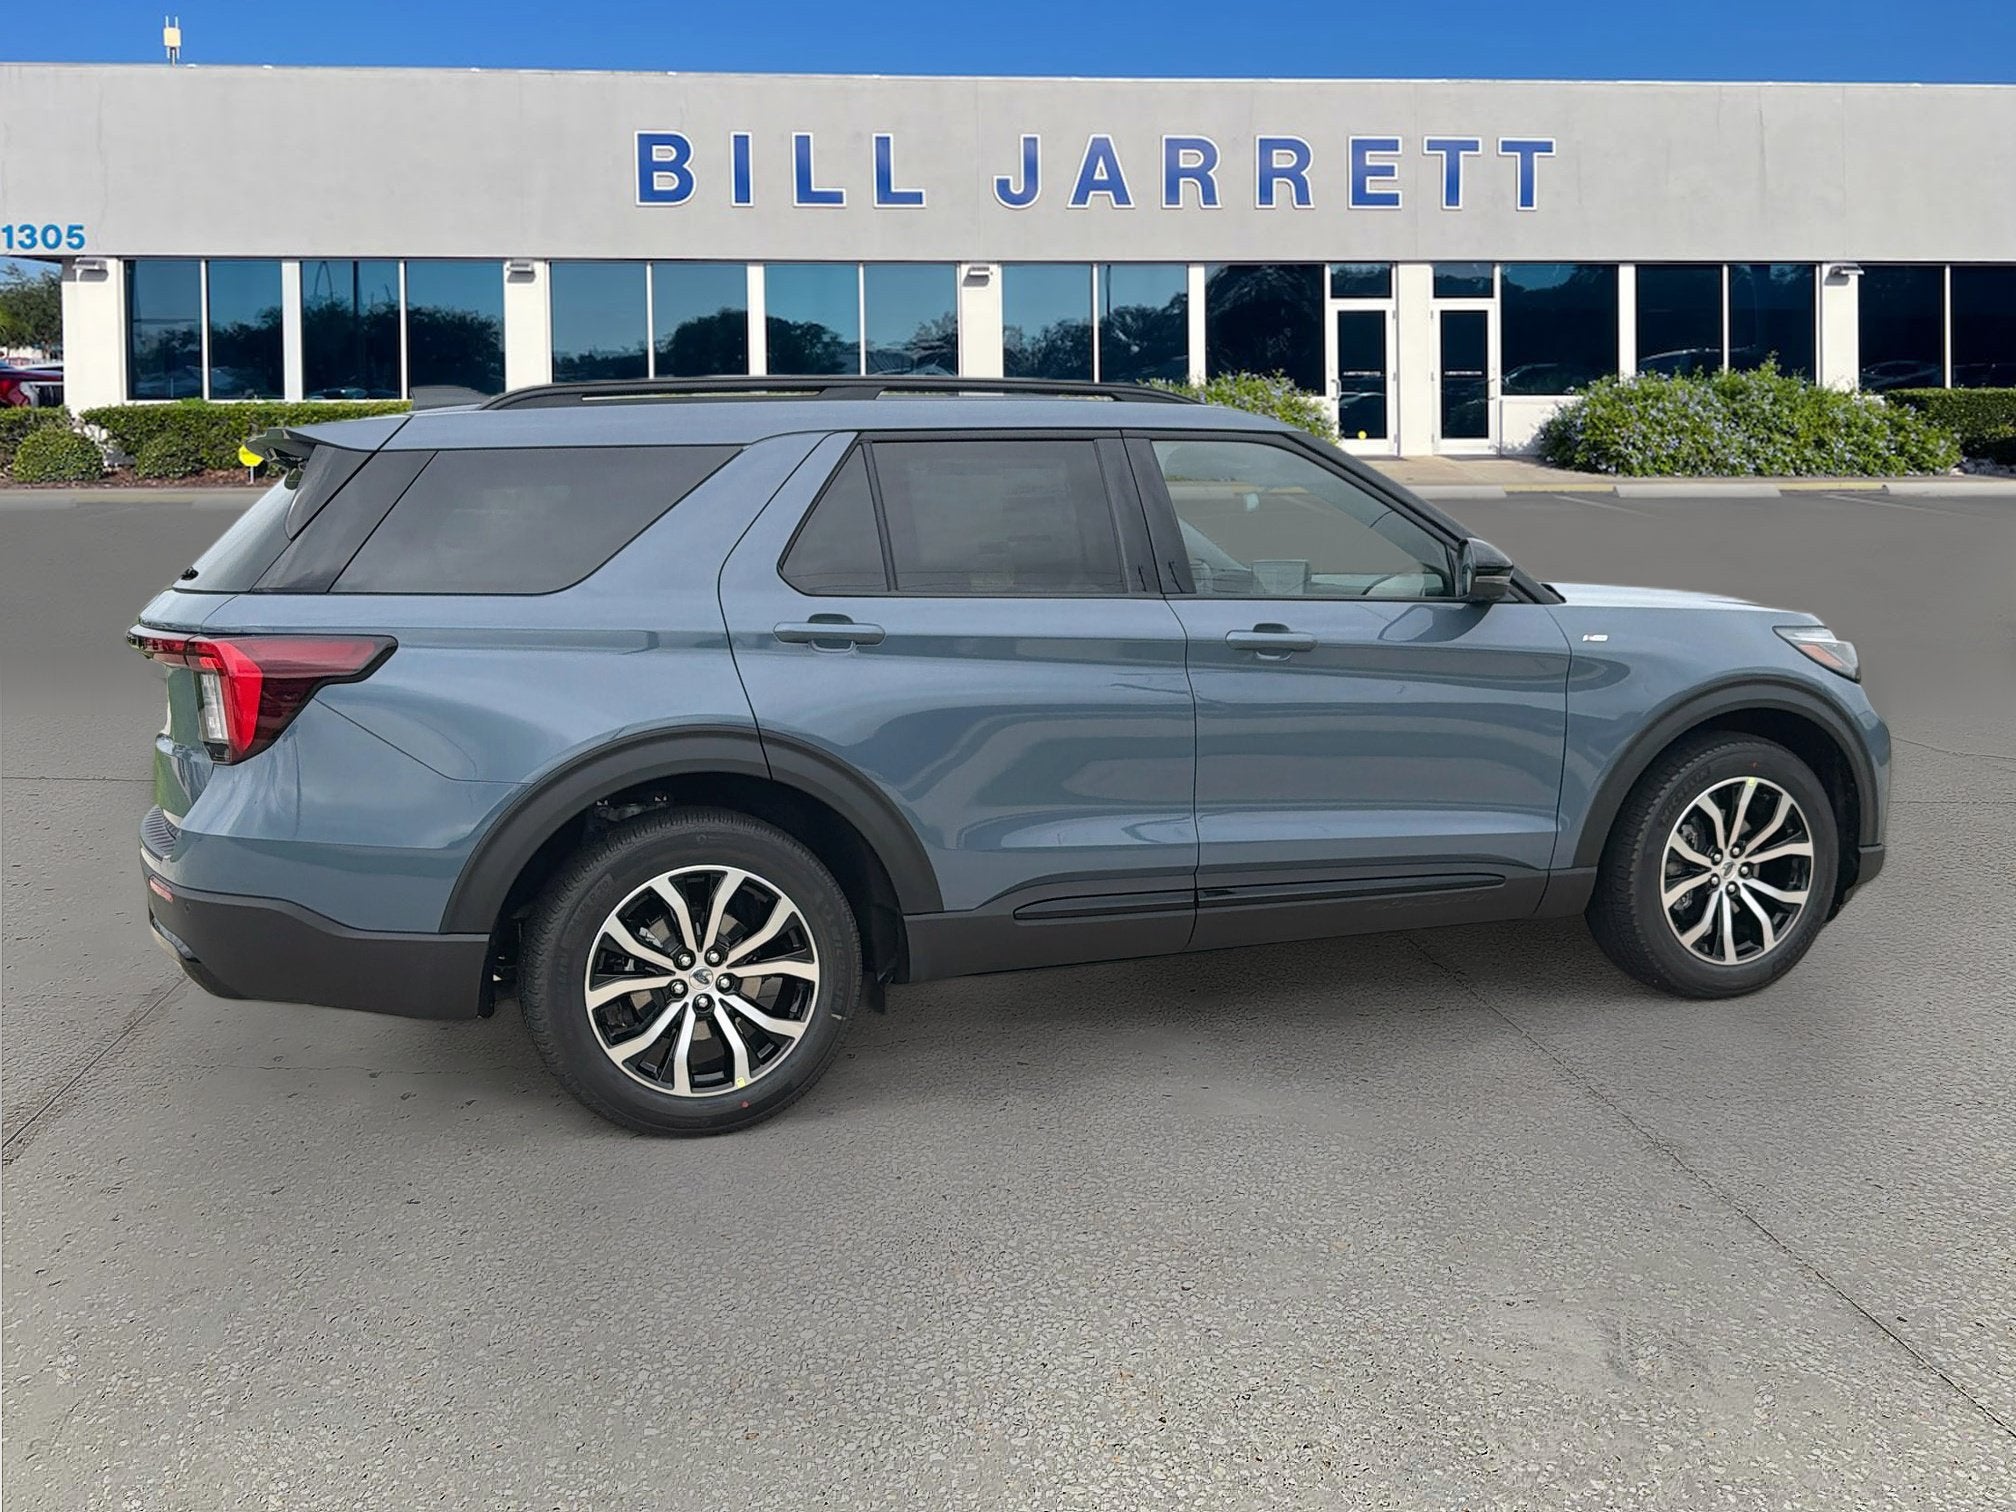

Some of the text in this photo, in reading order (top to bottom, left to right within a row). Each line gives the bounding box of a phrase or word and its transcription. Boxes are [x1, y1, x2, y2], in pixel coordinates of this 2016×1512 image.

[635, 130, 1556, 212] BILL JARRETT
[1, 223, 86, 250] 1305
